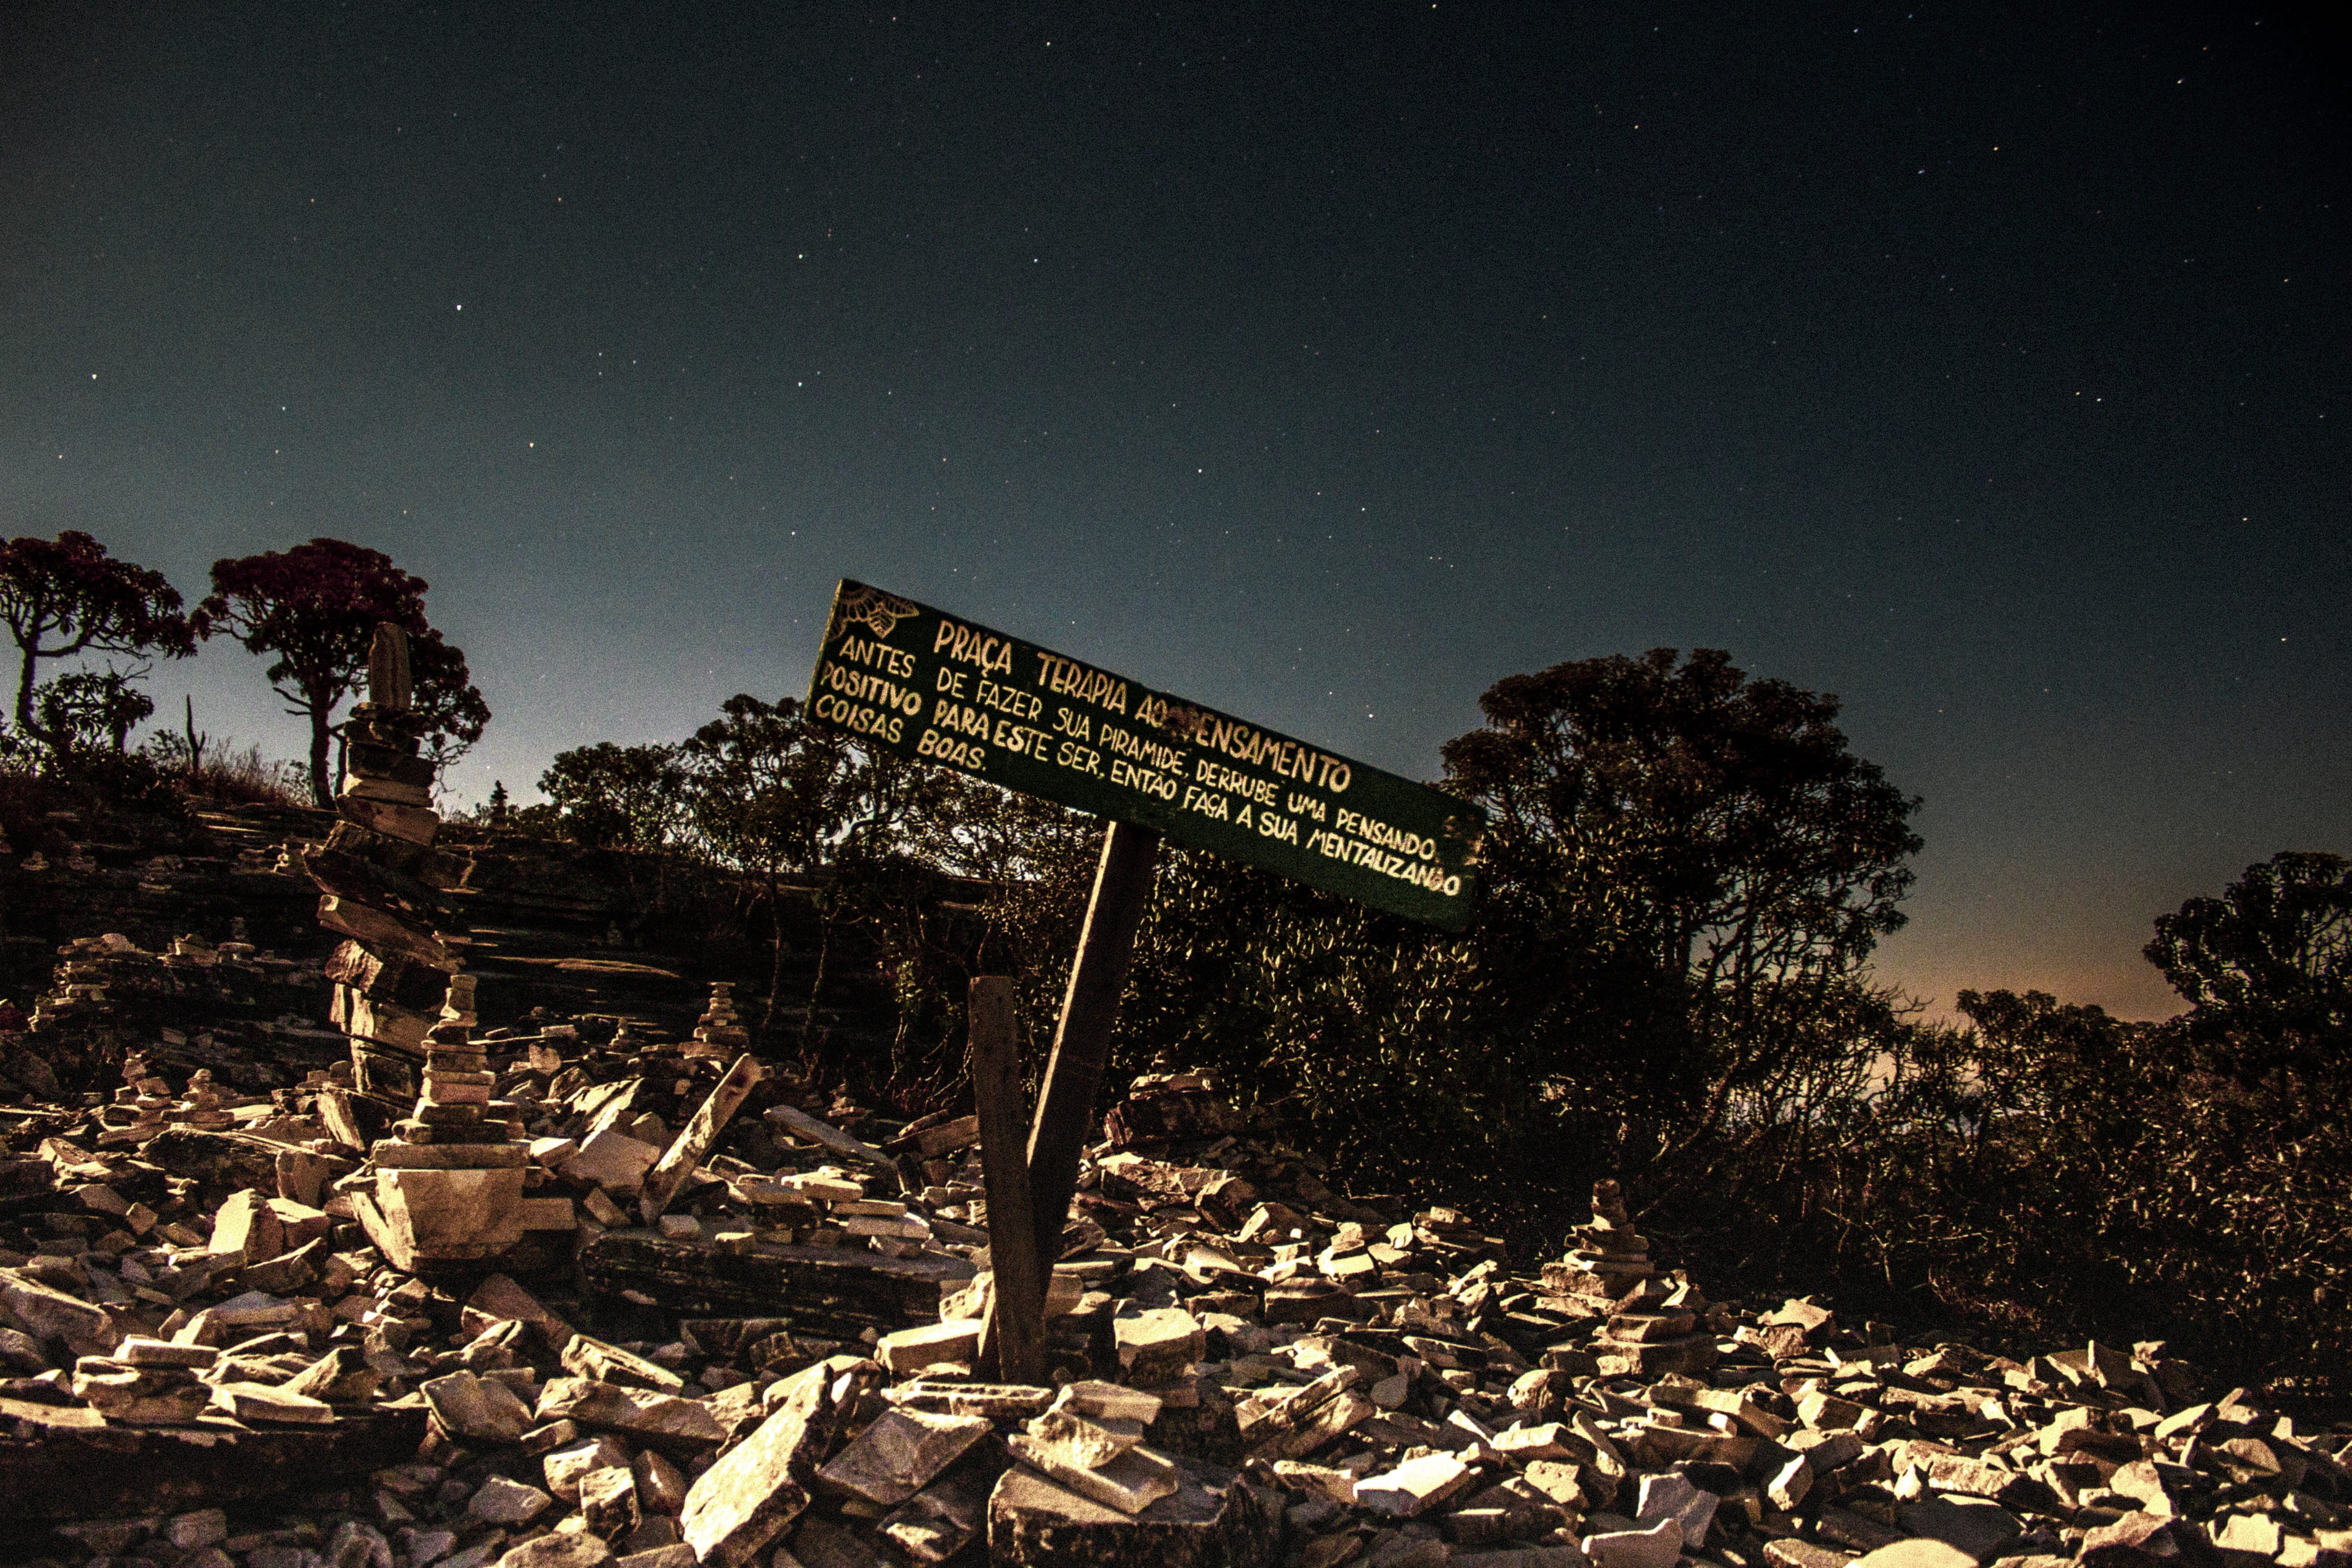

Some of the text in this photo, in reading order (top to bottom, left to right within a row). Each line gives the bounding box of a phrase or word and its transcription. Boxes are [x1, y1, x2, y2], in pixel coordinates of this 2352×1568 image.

[816, 694, 986, 771] COISAS BOAS.
[934, 620, 1011, 677] PRAÇA
[1037, 652, 1127, 715] TERAPIA
[820, 660, 922, 716] POSITIVO
[933, 699, 989, 740] PARA
[992, 720, 1053, 762] ESTE
[1057, 741, 1105, 779] SER,
[1182, 785, 1229, 821] FAÇA
[1235, 804, 1252, 828] A
[1259, 811, 1298, 846] SUA
[839, 635, 916, 677] ANTES
[936, 667, 968, 699] DE
[975, 680, 1043, 722] FAZER
[1053, 707, 1089, 741] SUA
[1196, 759, 1280, 807] DERRUBE
[1287, 791, 1326, 822] UMA
[1335, 808, 1436, 861] PENSANDO
